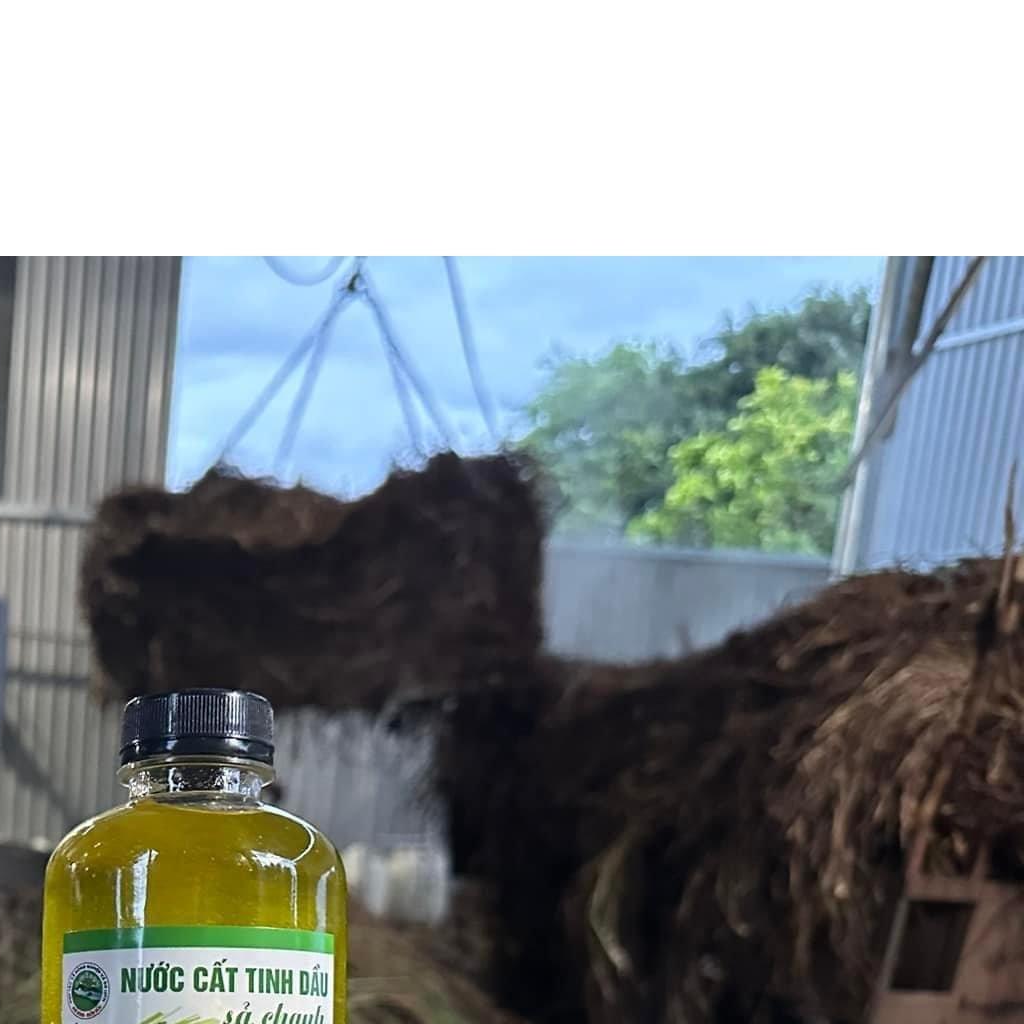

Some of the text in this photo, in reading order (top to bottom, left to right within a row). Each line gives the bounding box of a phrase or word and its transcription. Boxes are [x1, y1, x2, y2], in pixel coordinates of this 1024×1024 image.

[121, 961, 184, 992] NƯỚC
[193, 958, 238, 992] CẤT
[245, 967, 293, 994] TINH
[299, 963, 328, 997] DẦU
